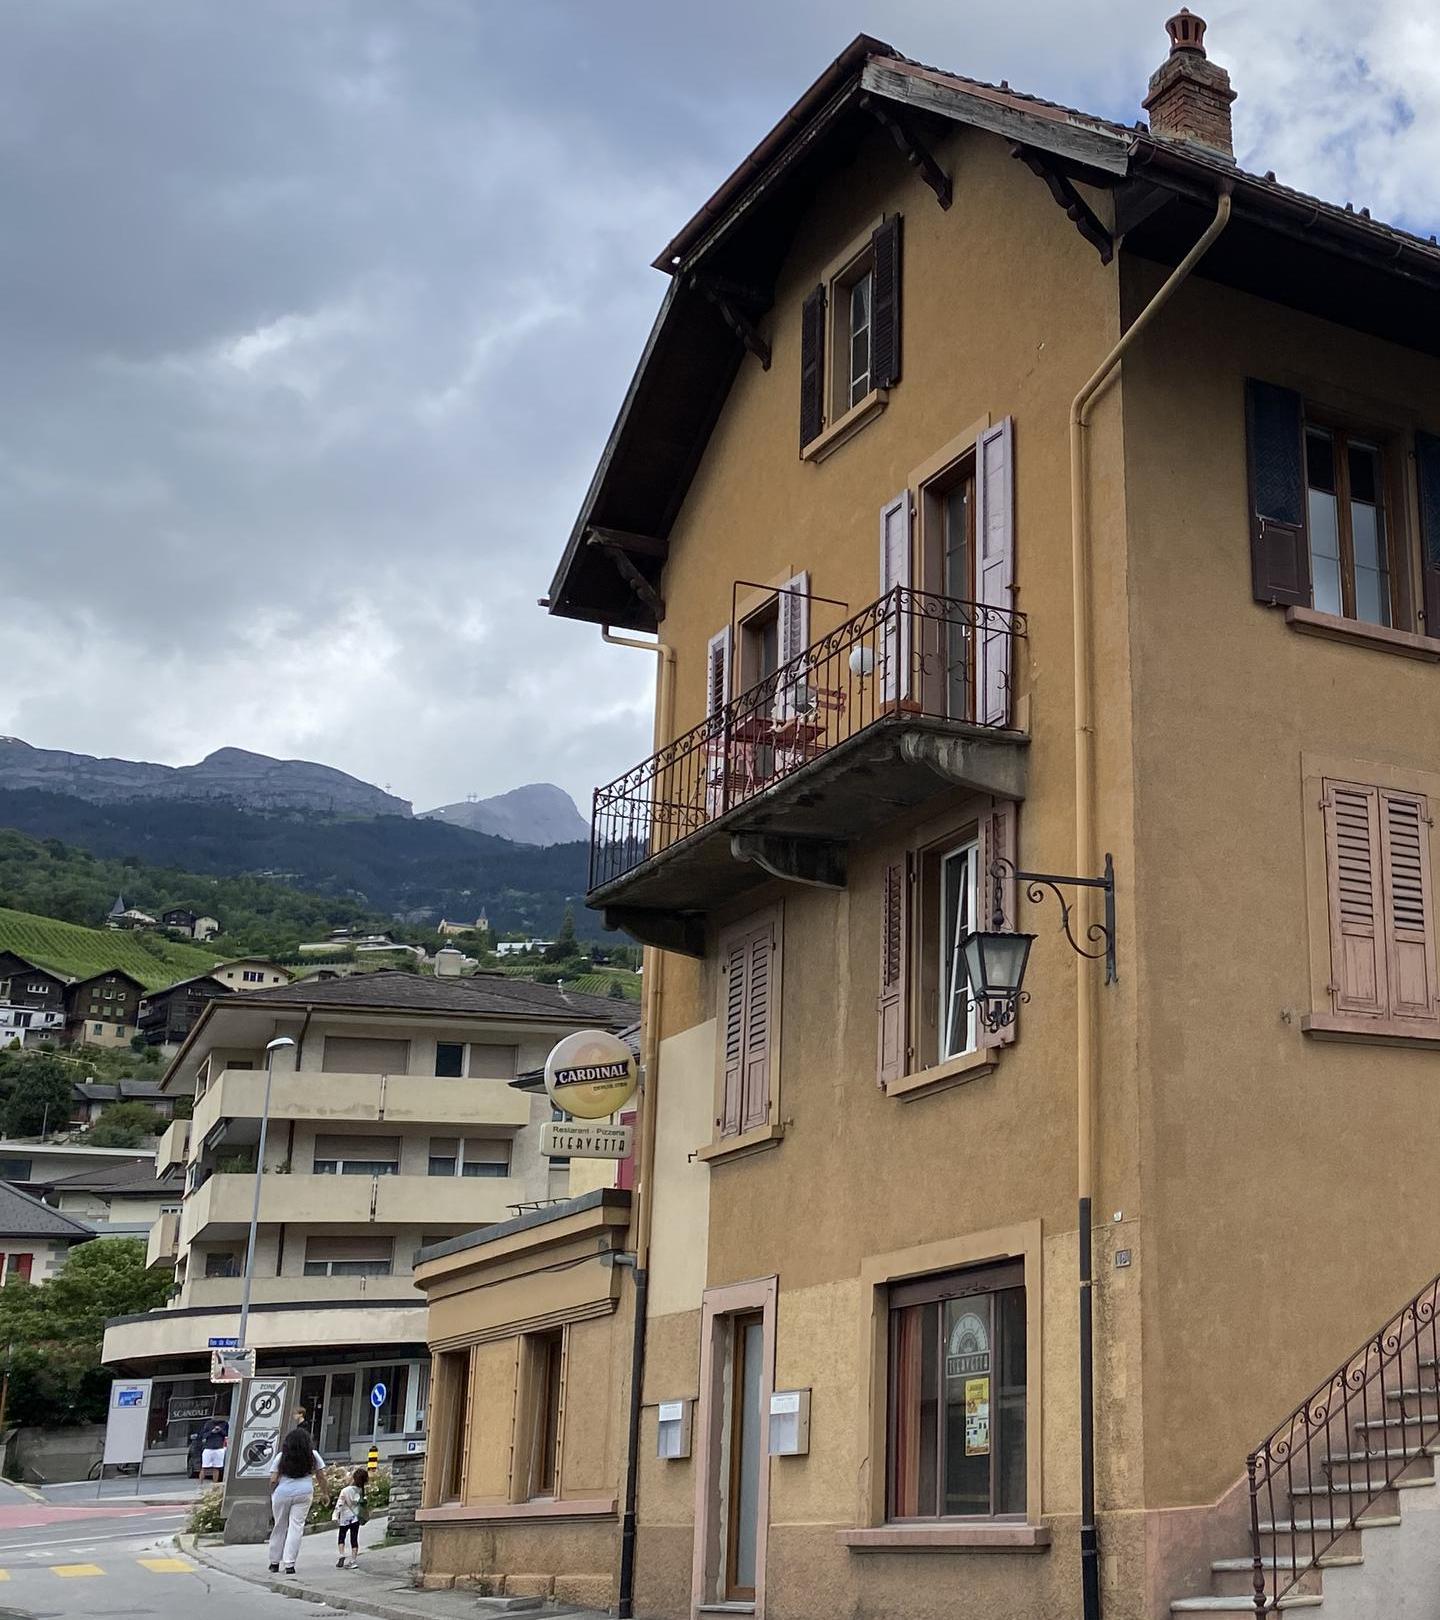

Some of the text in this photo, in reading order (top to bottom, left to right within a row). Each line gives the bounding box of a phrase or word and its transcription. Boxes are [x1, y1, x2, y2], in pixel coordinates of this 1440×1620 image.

[559, 1065, 626, 1084] CARDINAL
[596, 1128, 625, 1137] Pizzeria
[260, 1399, 272, 1410] 30
[252, 1431, 270, 1439] ZONE
